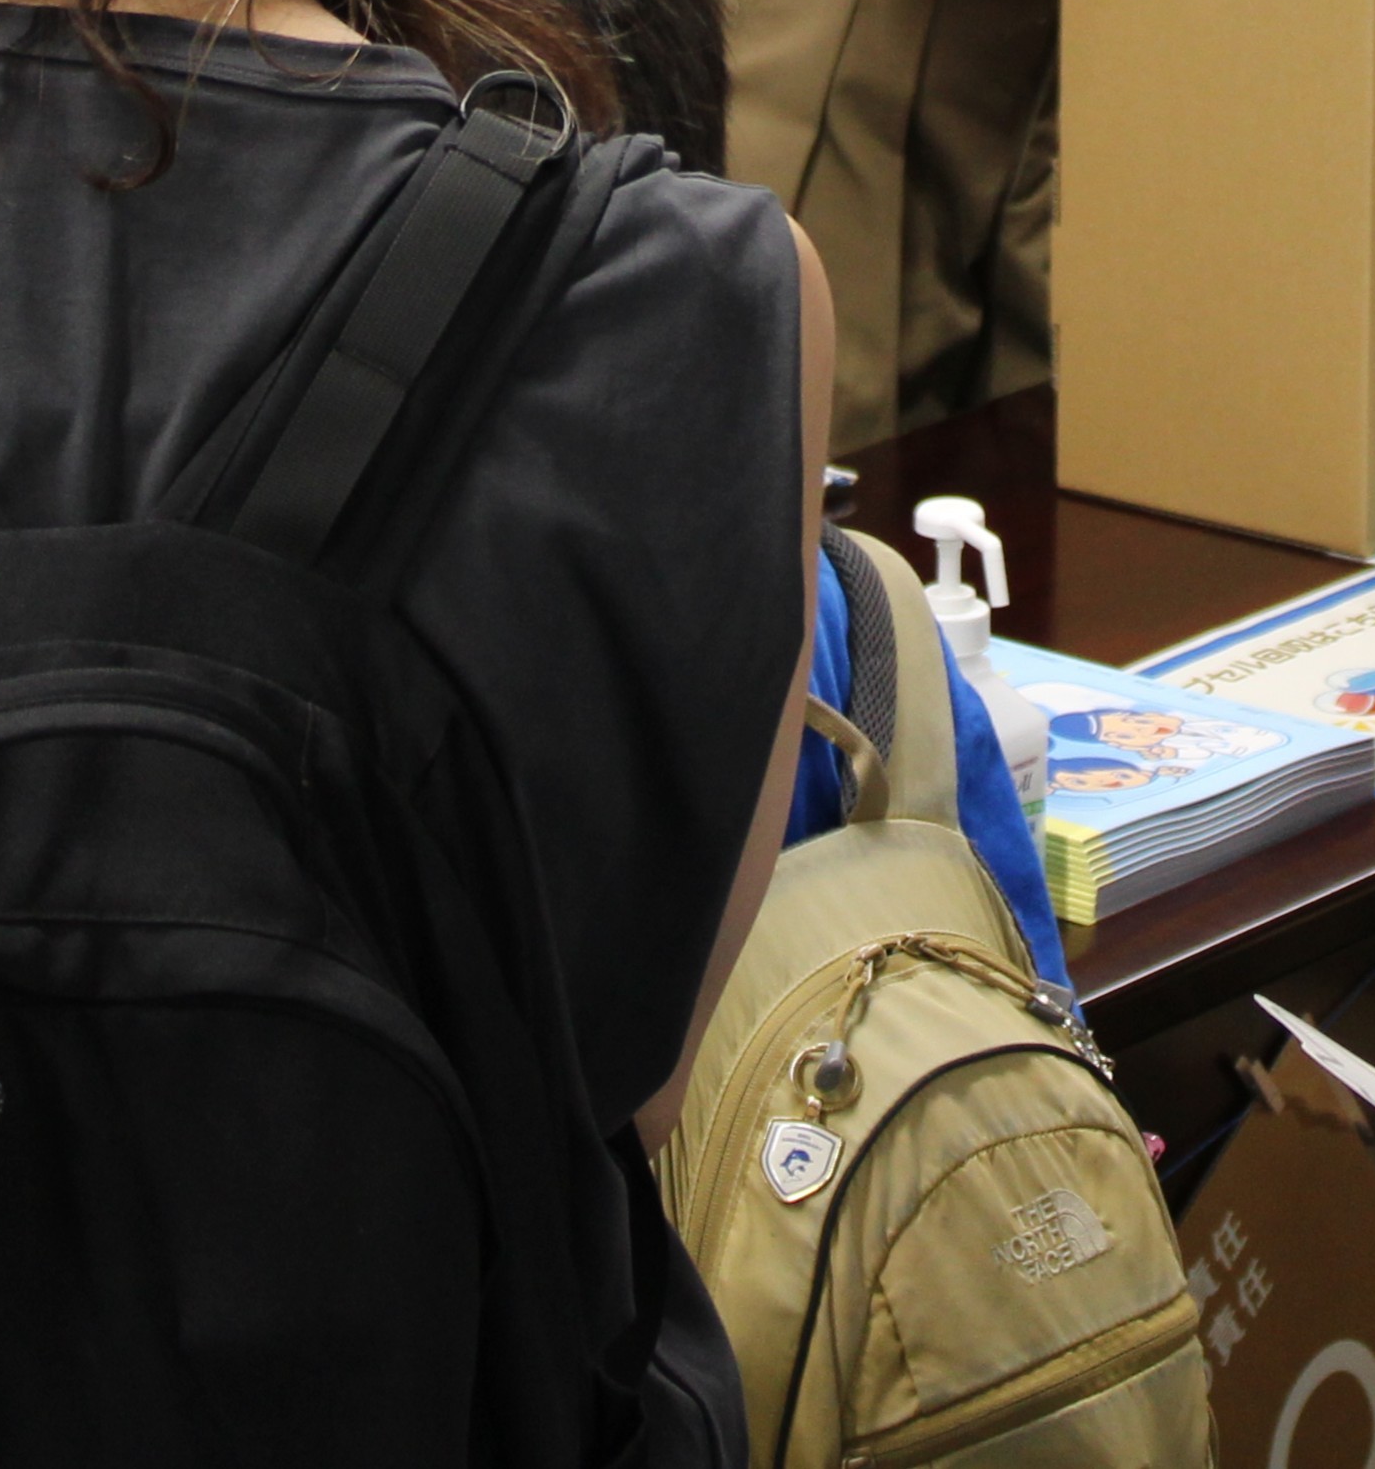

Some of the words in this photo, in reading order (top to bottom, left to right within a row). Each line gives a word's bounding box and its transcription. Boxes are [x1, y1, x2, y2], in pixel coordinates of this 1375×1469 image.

[1010, 1194, 1058, 1230] THE
[991, 1215, 1067, 1266] NORTH
[1022, 1241, 1077, 1284] FACE
